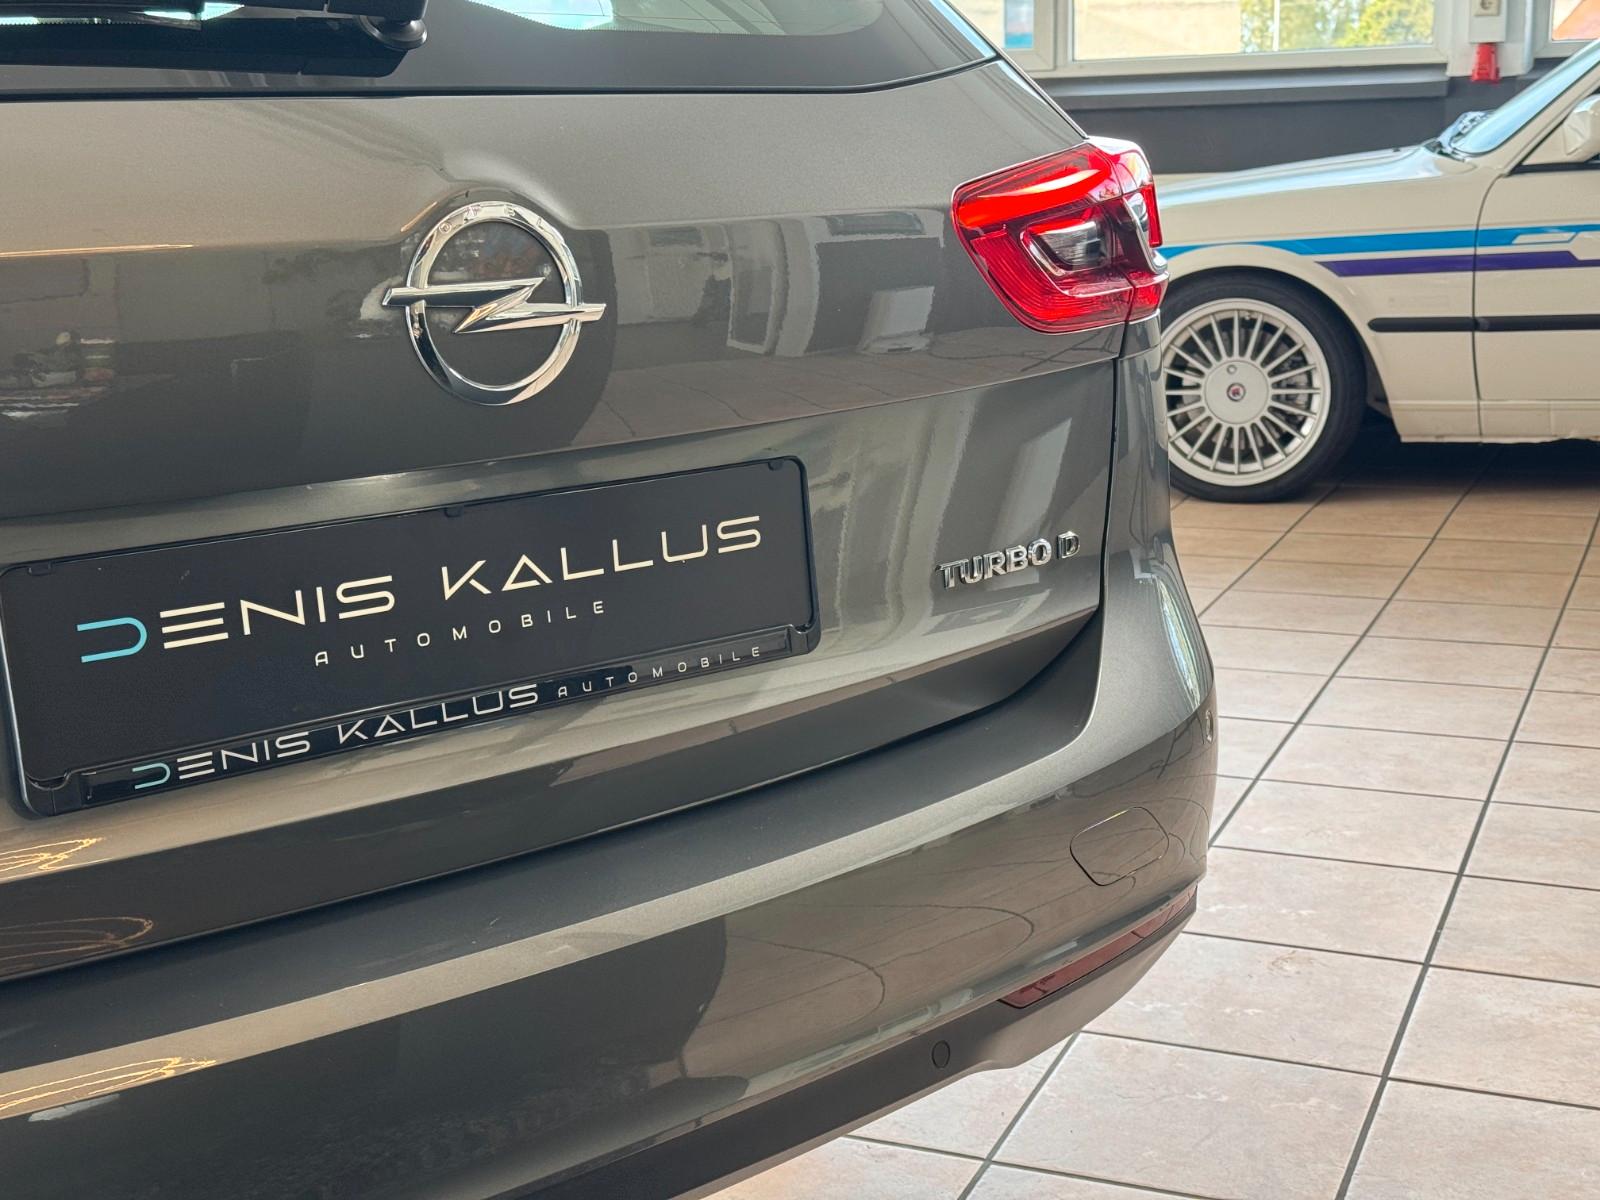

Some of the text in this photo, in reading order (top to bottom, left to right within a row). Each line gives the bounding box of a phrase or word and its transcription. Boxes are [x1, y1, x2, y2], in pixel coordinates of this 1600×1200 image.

[76, 515, 762, 664] DENIS KALLUS
[935, 530, 1081, 590] TURBO D
[314, 600, 604, 667] AUTOMOBILE
[132, 646, 760, 790] DENIS KALLUS AUTOMOBILE
